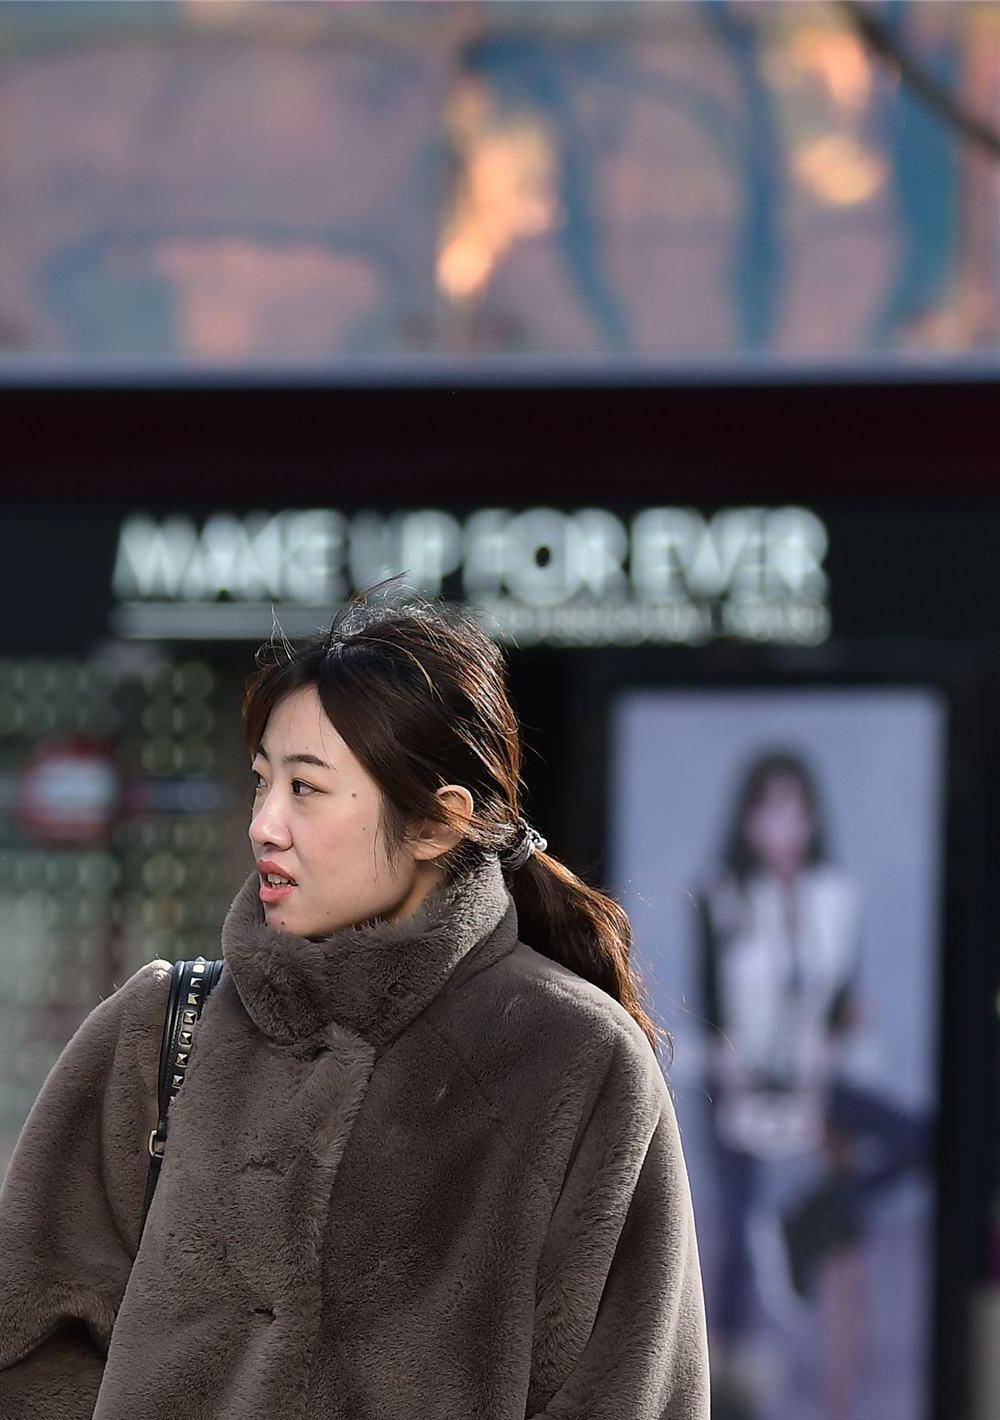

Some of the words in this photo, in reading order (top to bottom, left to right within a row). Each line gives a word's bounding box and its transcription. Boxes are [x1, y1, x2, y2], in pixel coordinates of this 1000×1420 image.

[113, 509, 347, 601] MAKE
[350, 509, 463, 600] UP
[464, 508, 627, 603] FOR
[630, 507, 828, 601] EVER
